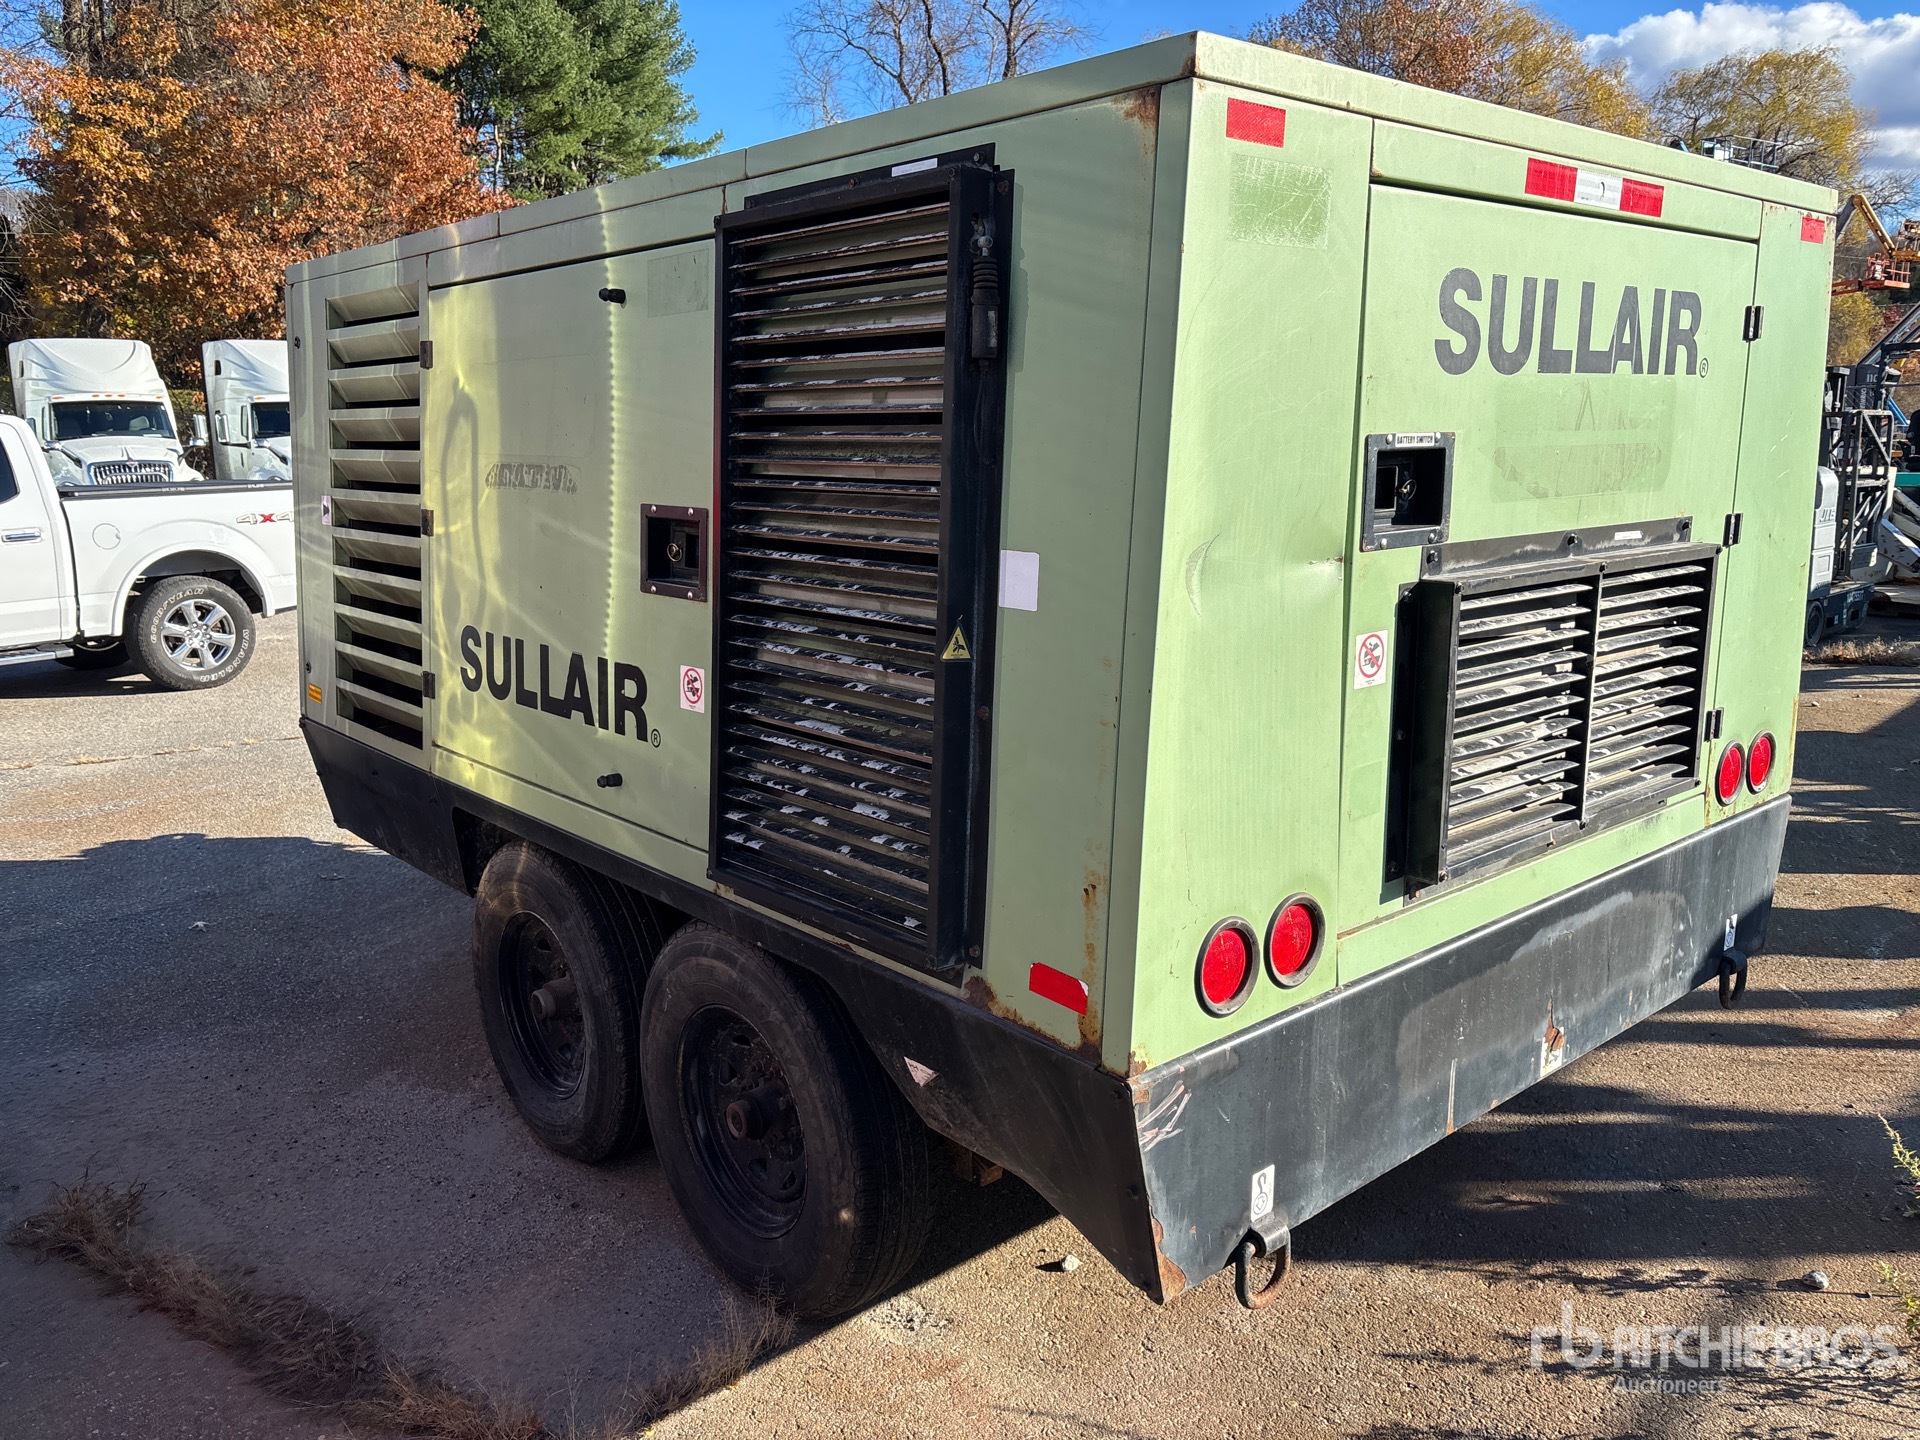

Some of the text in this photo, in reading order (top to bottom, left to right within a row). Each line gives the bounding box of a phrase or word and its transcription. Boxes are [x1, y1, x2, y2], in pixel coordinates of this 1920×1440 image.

[1434, 267, 1702, 376] SULLAIR
[150, 587, 205, 644] GOODYEAR
[200, 628, 251, 683] WRANGLER
[460, 624, 649, 743] SULLAIR
